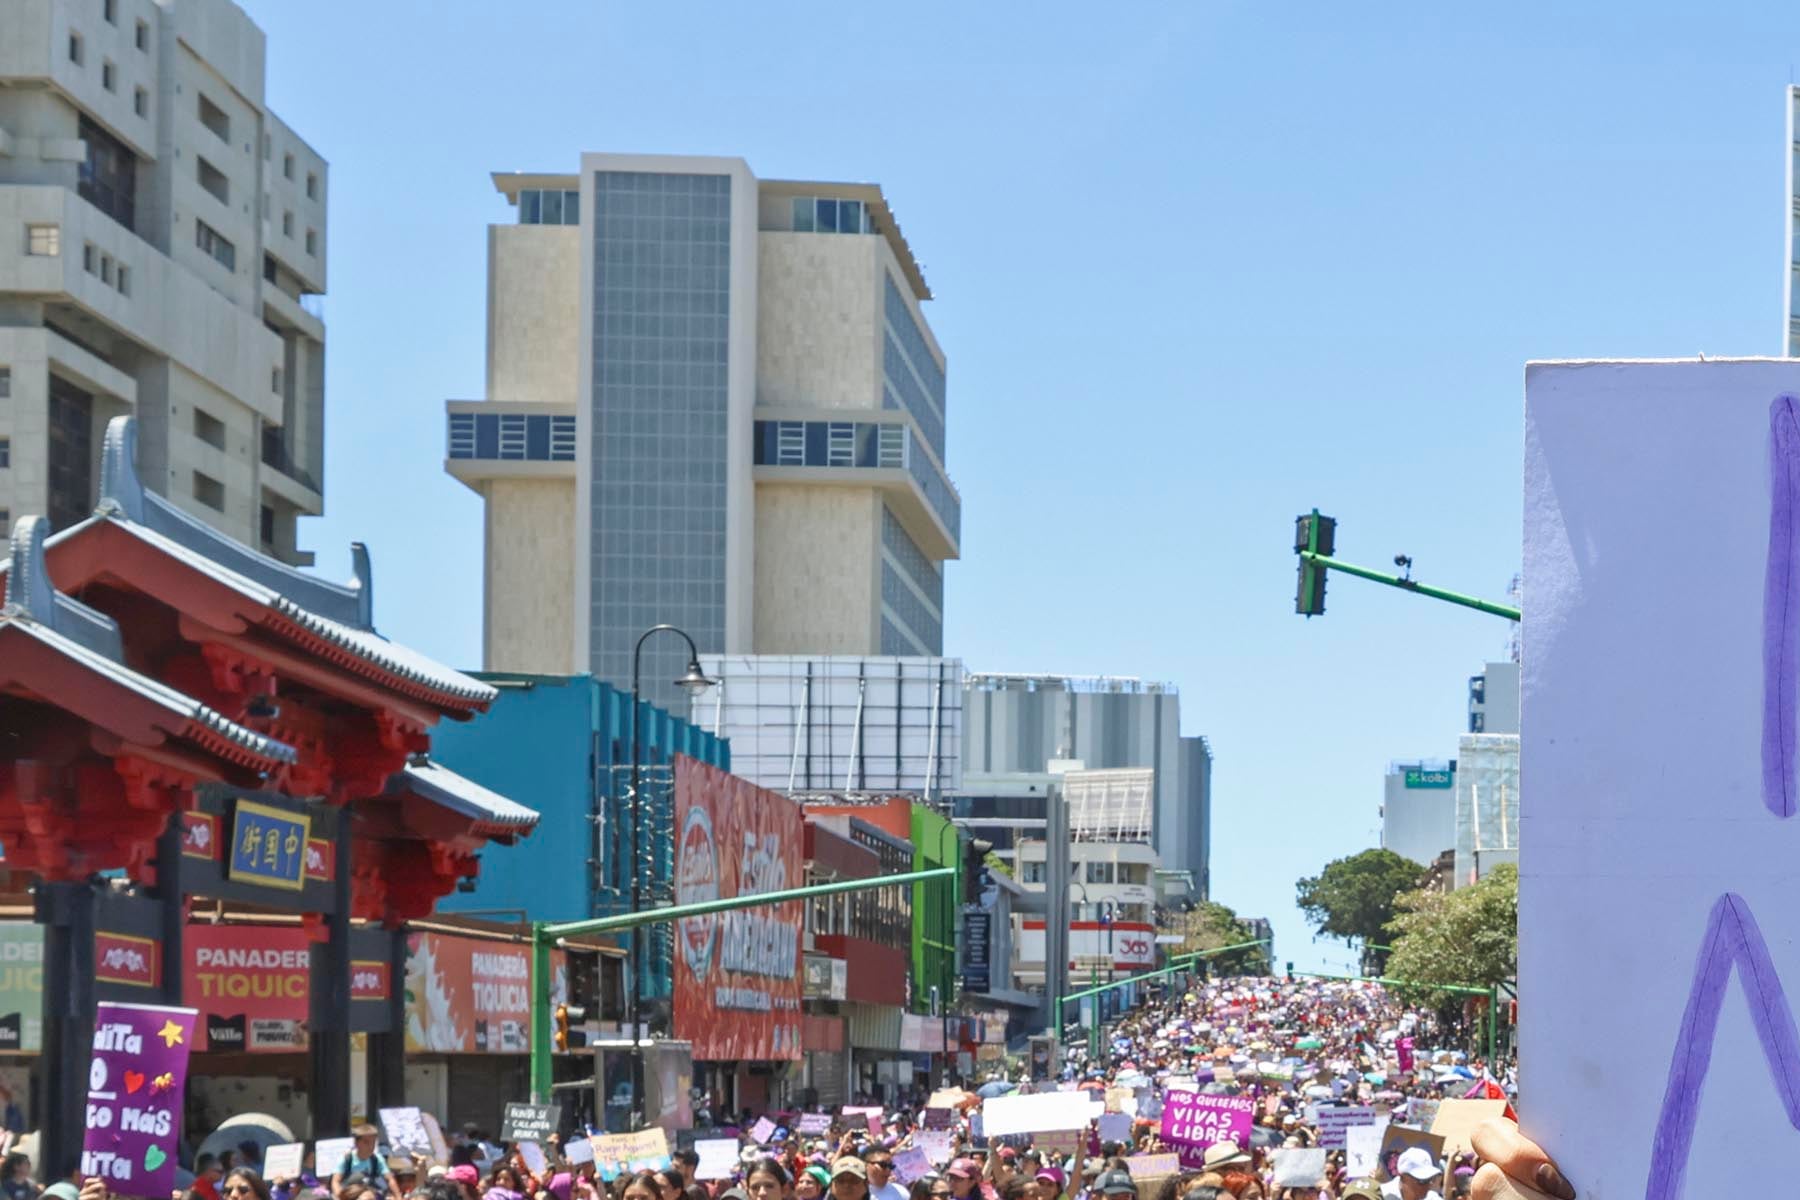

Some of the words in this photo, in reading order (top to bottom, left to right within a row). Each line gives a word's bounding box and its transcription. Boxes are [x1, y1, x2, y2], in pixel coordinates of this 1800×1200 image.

[472, 951, 529, 979] PANADERÍA
[197, 973, 305, 997] TIQUIC
[472, 982, 529, 1014] TIQUICIA
[1173, 1107, 1232, 1129] VIVAS
[1171, 1126, 1240, 1145] LIBRES
